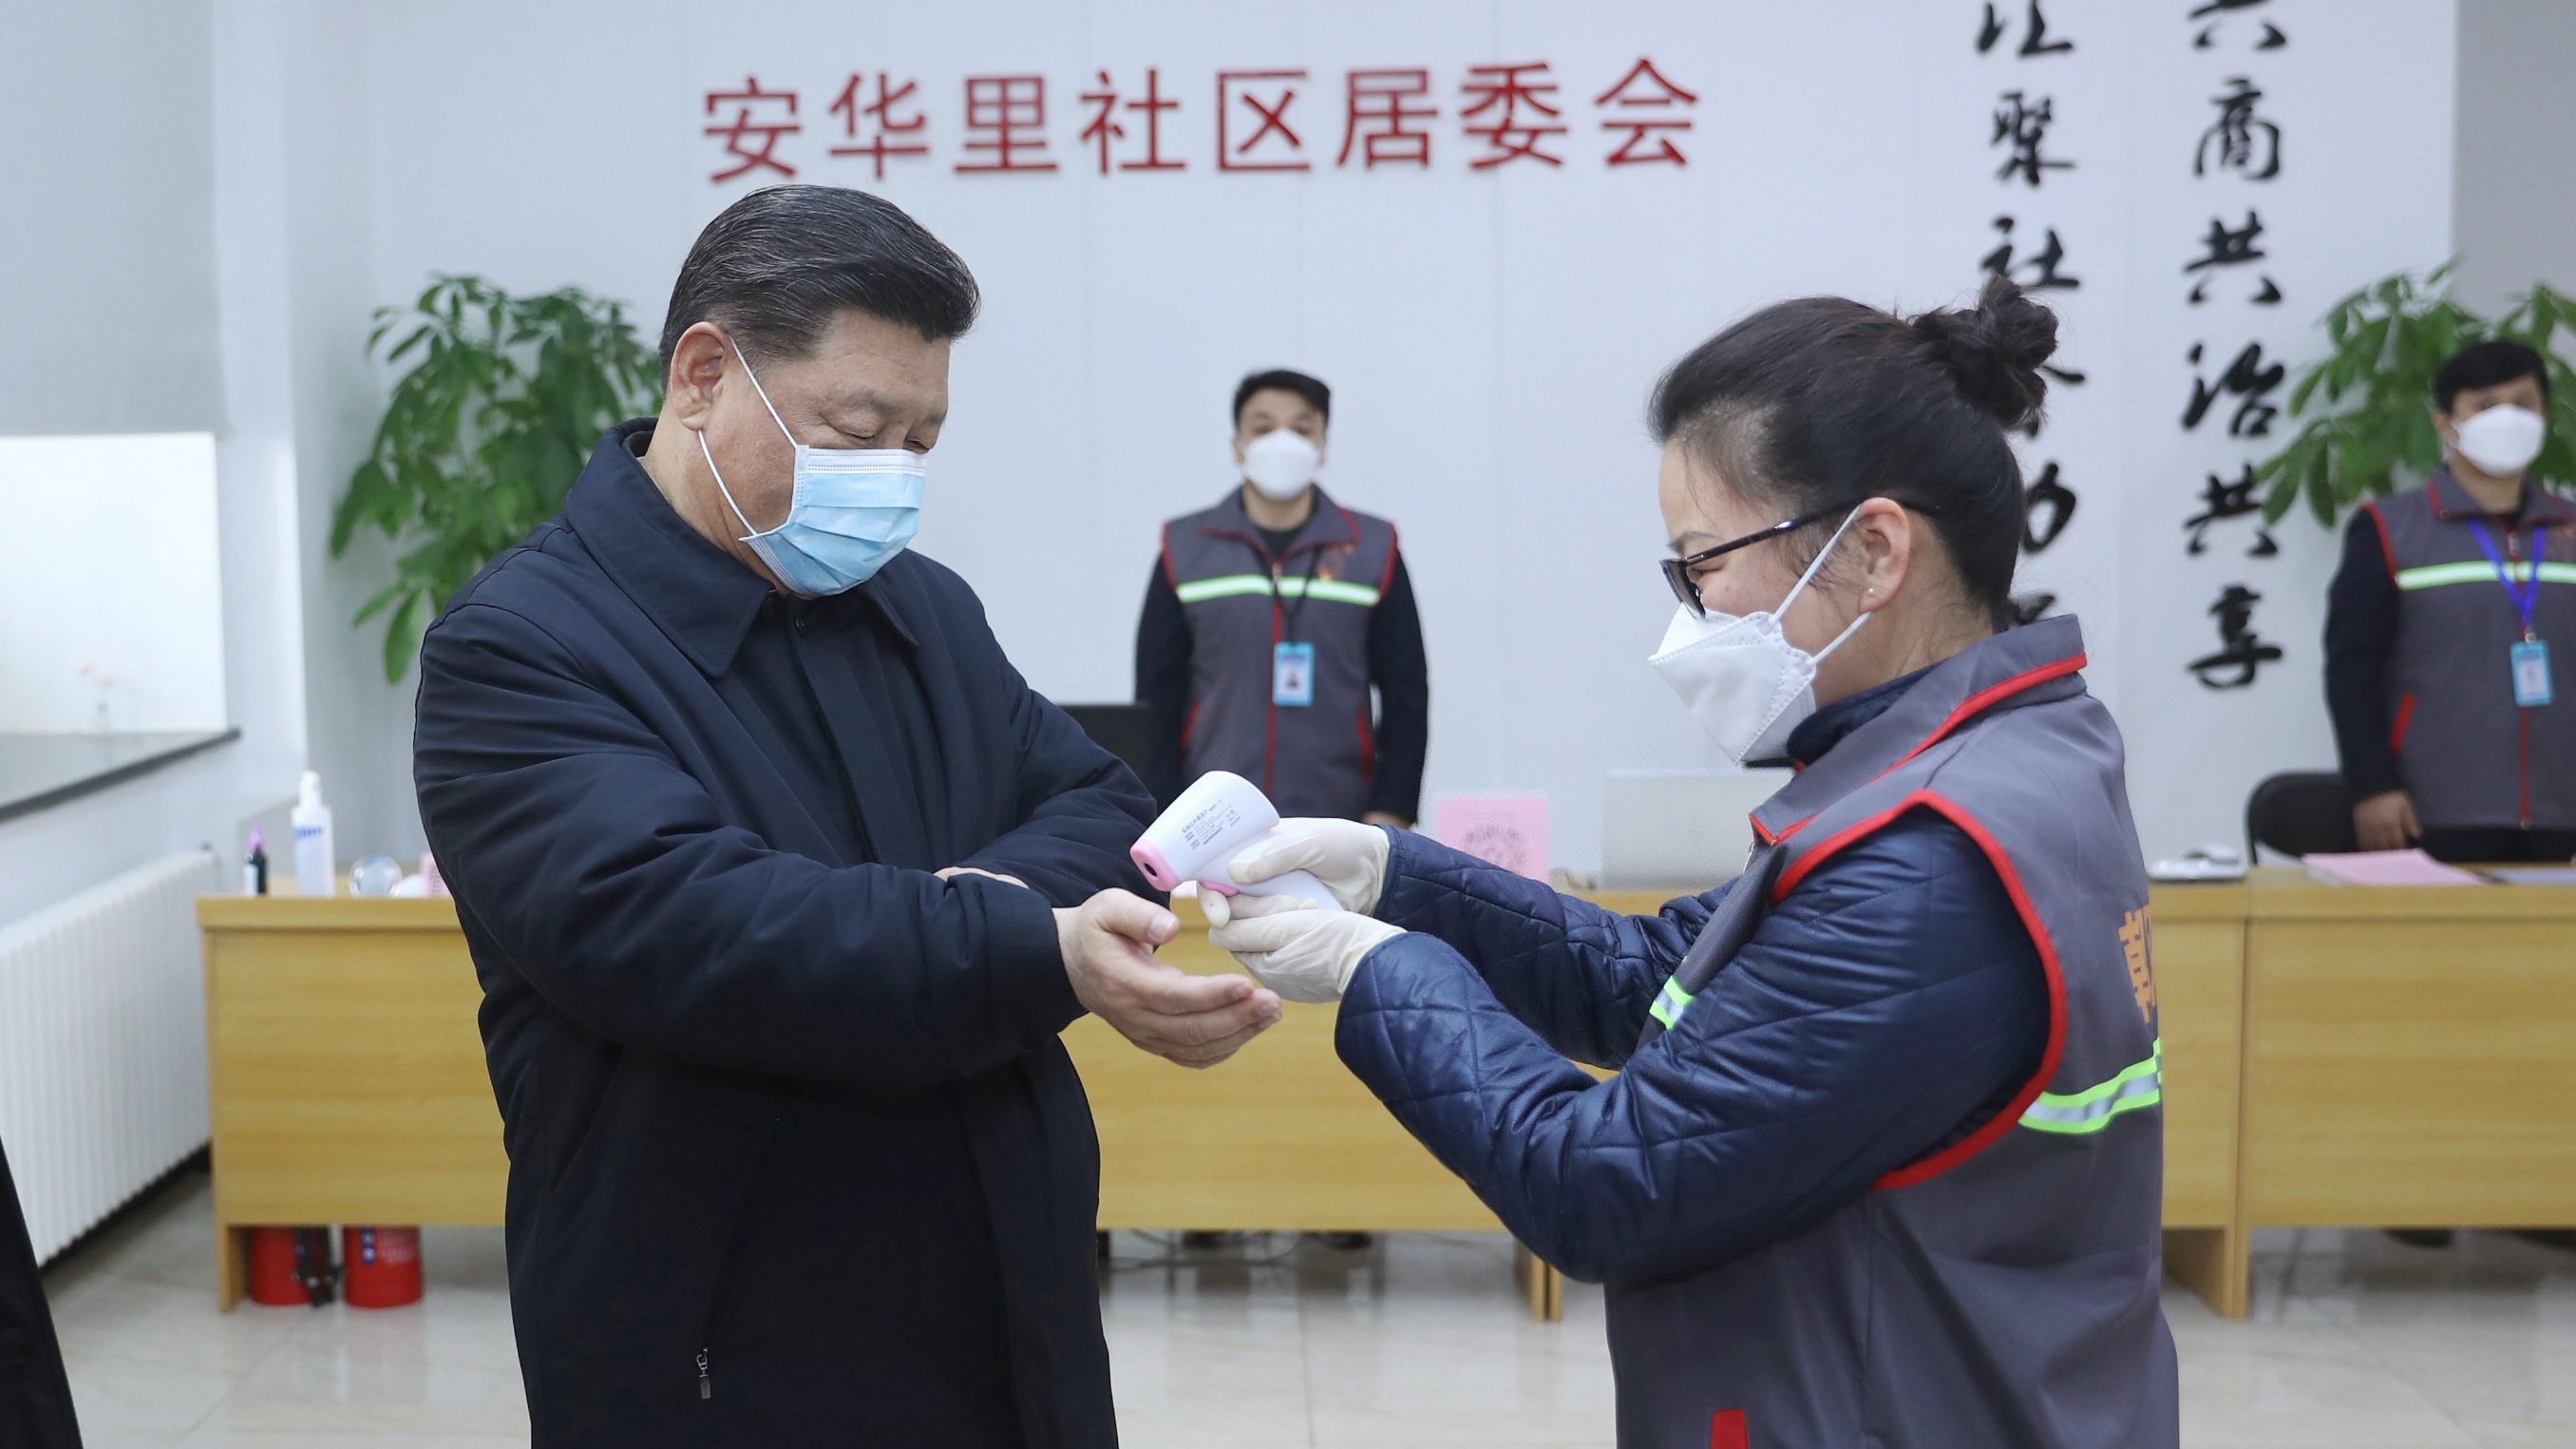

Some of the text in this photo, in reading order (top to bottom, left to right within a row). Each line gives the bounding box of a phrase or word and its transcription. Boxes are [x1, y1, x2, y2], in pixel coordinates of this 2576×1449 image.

[703, 56, 1698, 185] 安华里社区居委会
